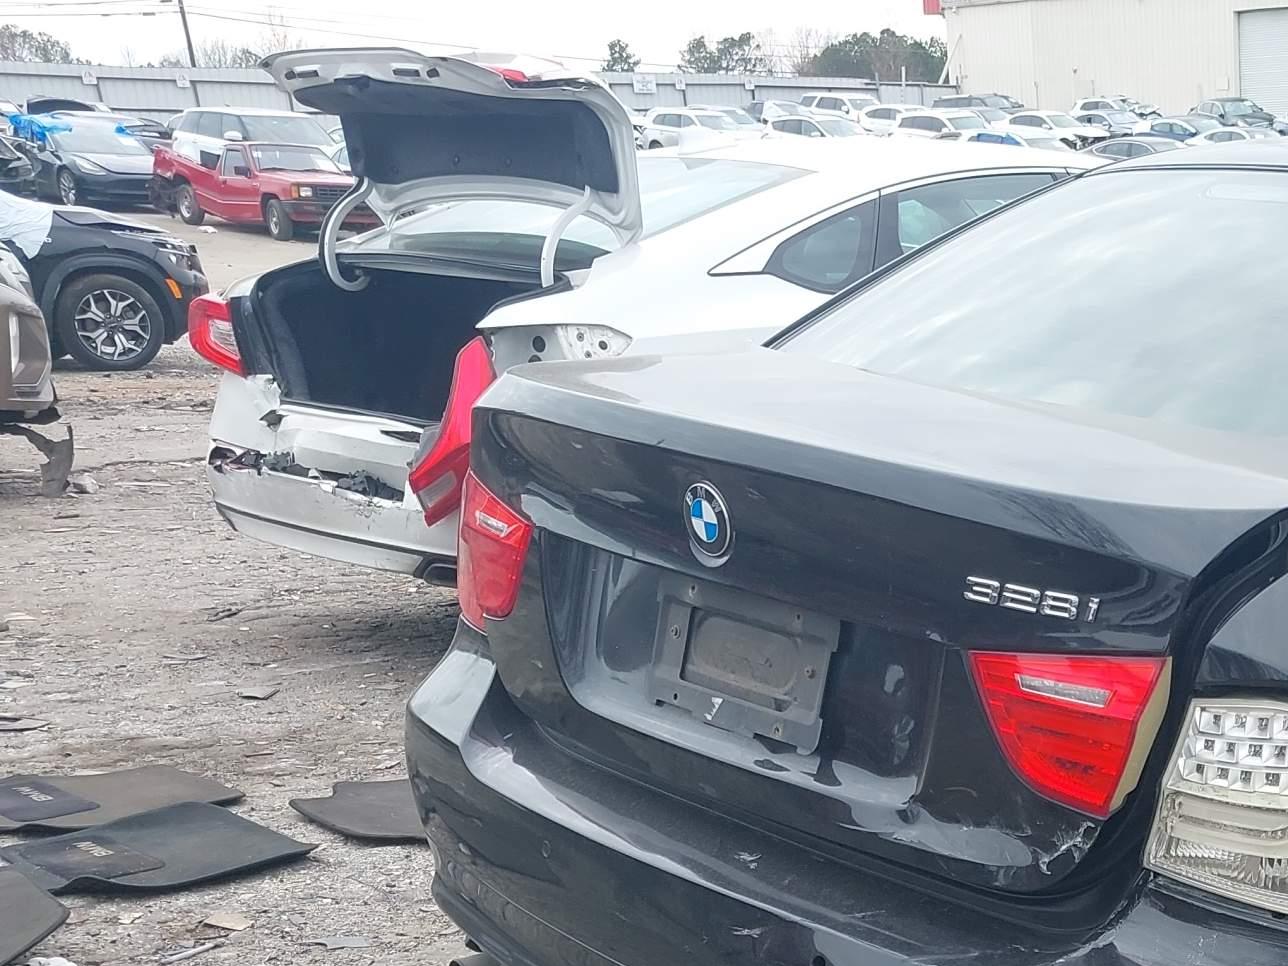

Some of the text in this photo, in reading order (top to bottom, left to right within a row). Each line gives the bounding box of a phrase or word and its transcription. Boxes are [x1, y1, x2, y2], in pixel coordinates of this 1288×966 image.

[686, 486, 721, 513] BMW
[963, 576, 1100, 623] 328i
[12, 786, 54, 802] BMW
[72, 841, 115, 857] BMW
